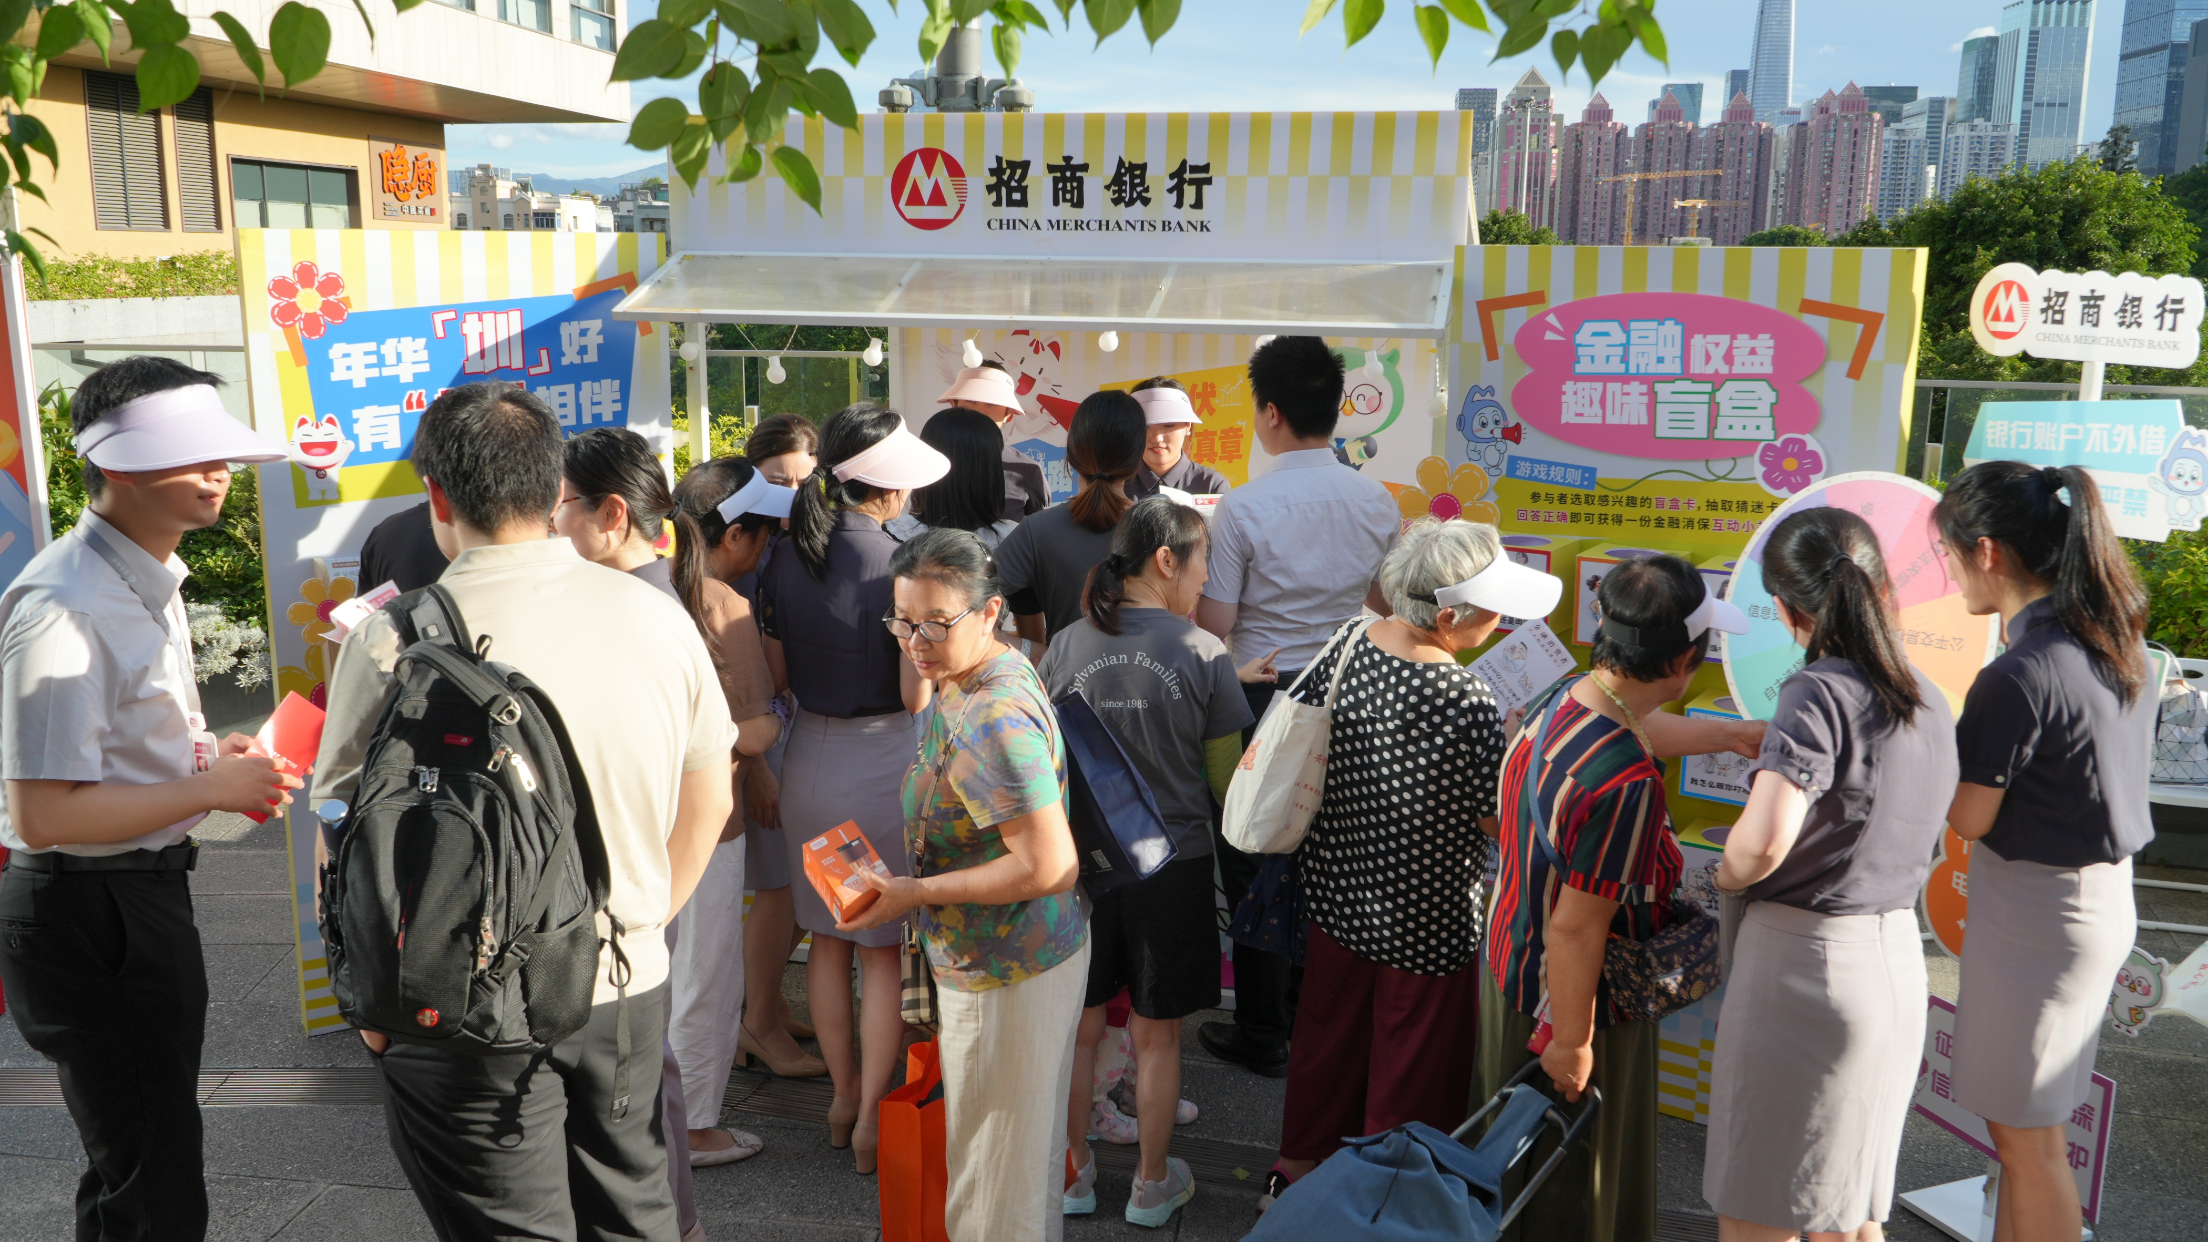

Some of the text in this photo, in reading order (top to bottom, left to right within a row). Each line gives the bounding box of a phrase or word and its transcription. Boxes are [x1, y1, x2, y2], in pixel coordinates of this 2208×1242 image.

[379, 143, 437, 202] 隐厨
[985, 154, 1213, 210] 招商銀行
[986, 218, 1212, 233] CHINA MERCHANTS BANK
[2040, 287, 2186, 332] 招商銀行
[2035, 332, 2181, 351] CHINA MERCHANTS BANK
[1560, 378, 1779, 442] 趣味盲盒
[1985, 420, 2166, 456] 银行账户不外借
[1133, 651, 1182, 700] Families
[1100, 699, 1149, 709] since 1985
